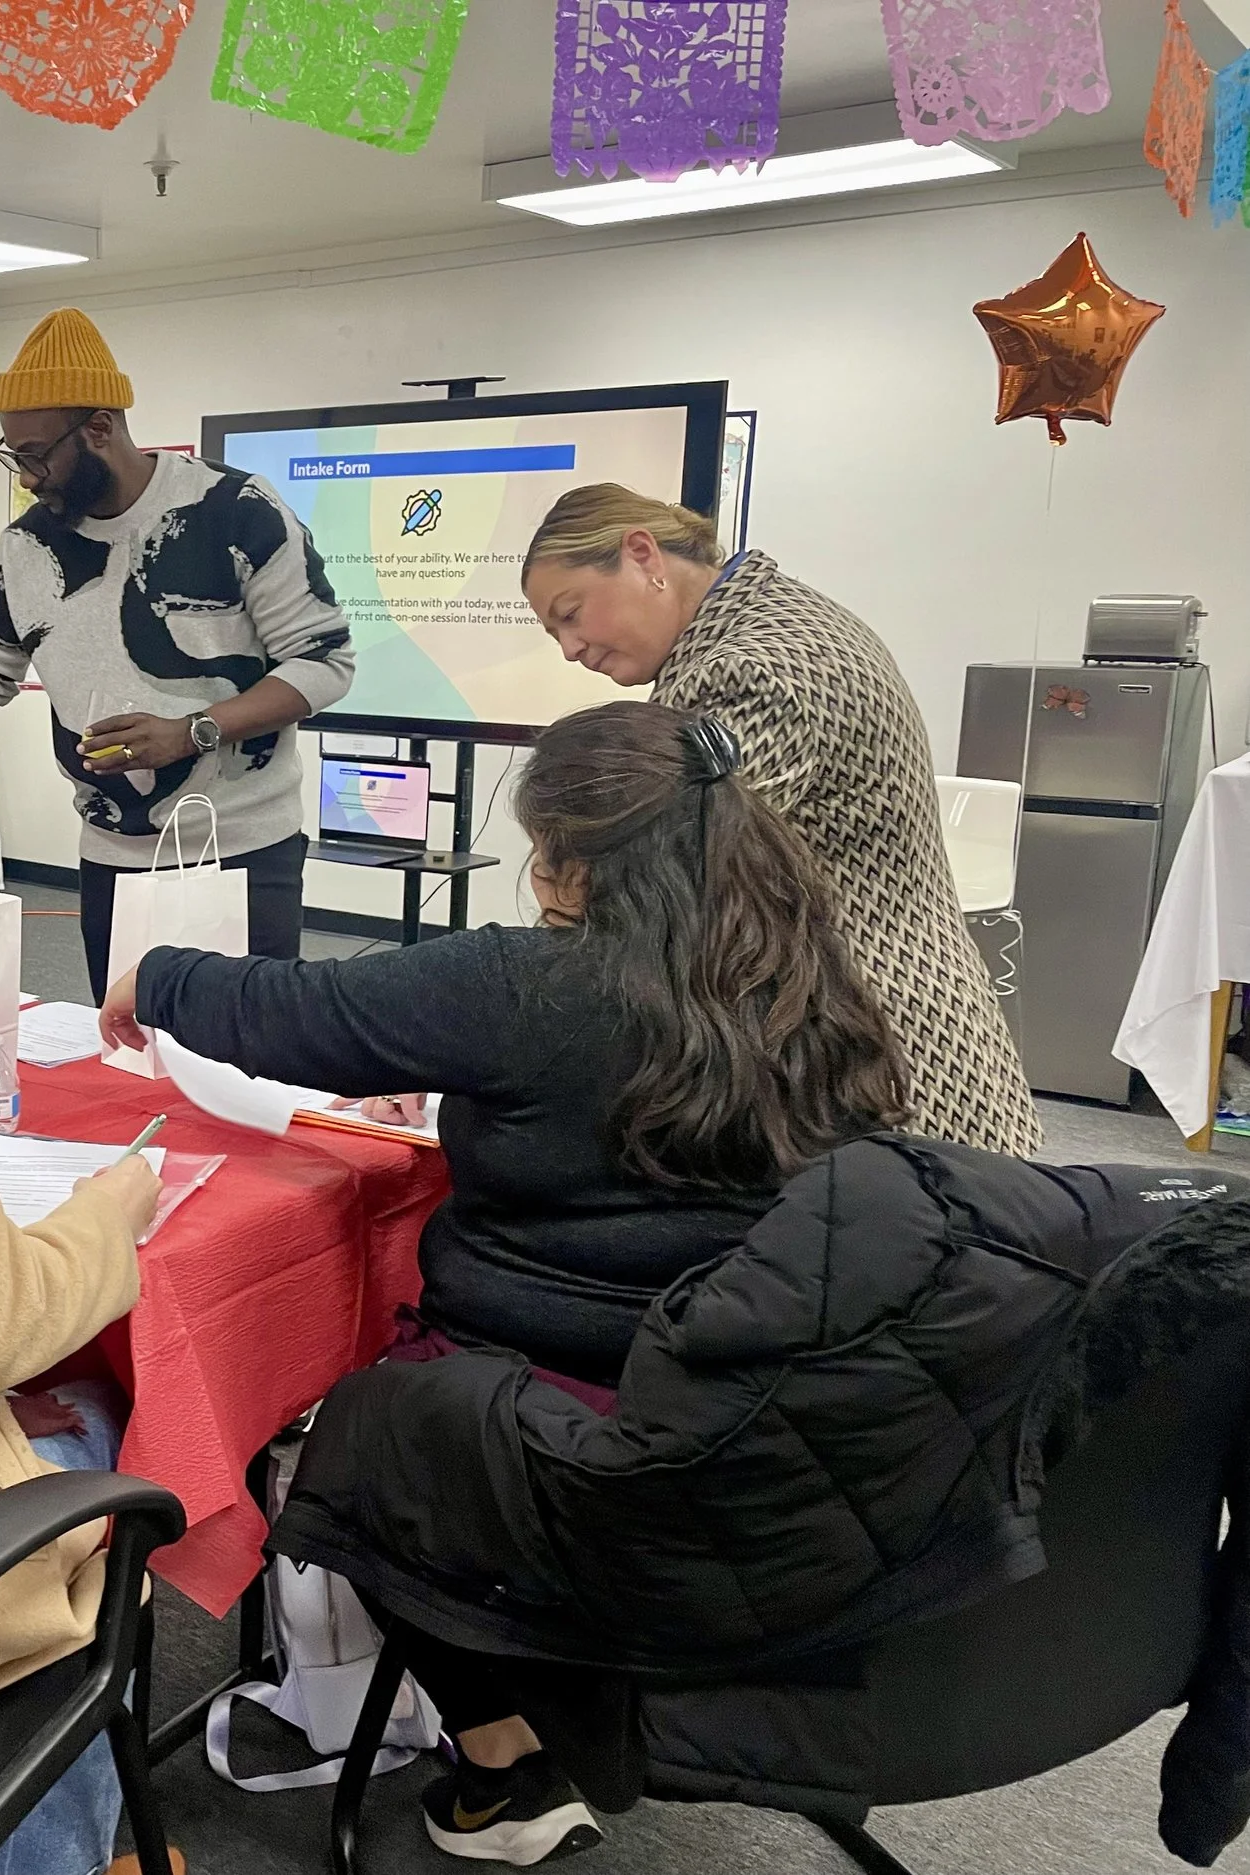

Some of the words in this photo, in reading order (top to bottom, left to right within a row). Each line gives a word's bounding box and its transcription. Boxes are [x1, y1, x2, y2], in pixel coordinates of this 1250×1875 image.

[293, 461, 334, 477] Intake
[336, 460, 370, 476] Form
[323, 553, 333, 563] ut
[335, 554, 345, 563] to
[346, 553, 362, 563] the
[363, 553, 383, 563] best
[384, 553, 396, 563] of
[396, 555, 418, 565] your
[419, 553, 452, 565] ability.
[454, 553, 471, 563] We
[473, 555, 490, 563] are
[491, 553, 515, 563] here
[375, 568, 398, 578] have
[399, 570, 417, 579] any
[418, 568, 466, 579] questions
[335, 599, 347, 607] ve
[348, 597, 419, 607] documentation
[420, 597, 442, 608] with
[444, 600, 462, 610] you
[464, 598, 495, 611] today,
[496, 601, 511, 609] we
[513, 601, 531, 609] can
[354, 611, 373, 621] first
[374, 613, 430, 622] one-on-one
[431, 613, 466, 623] session
[468, 613, 492, 624] later
[494, 613, 513, 624] this
